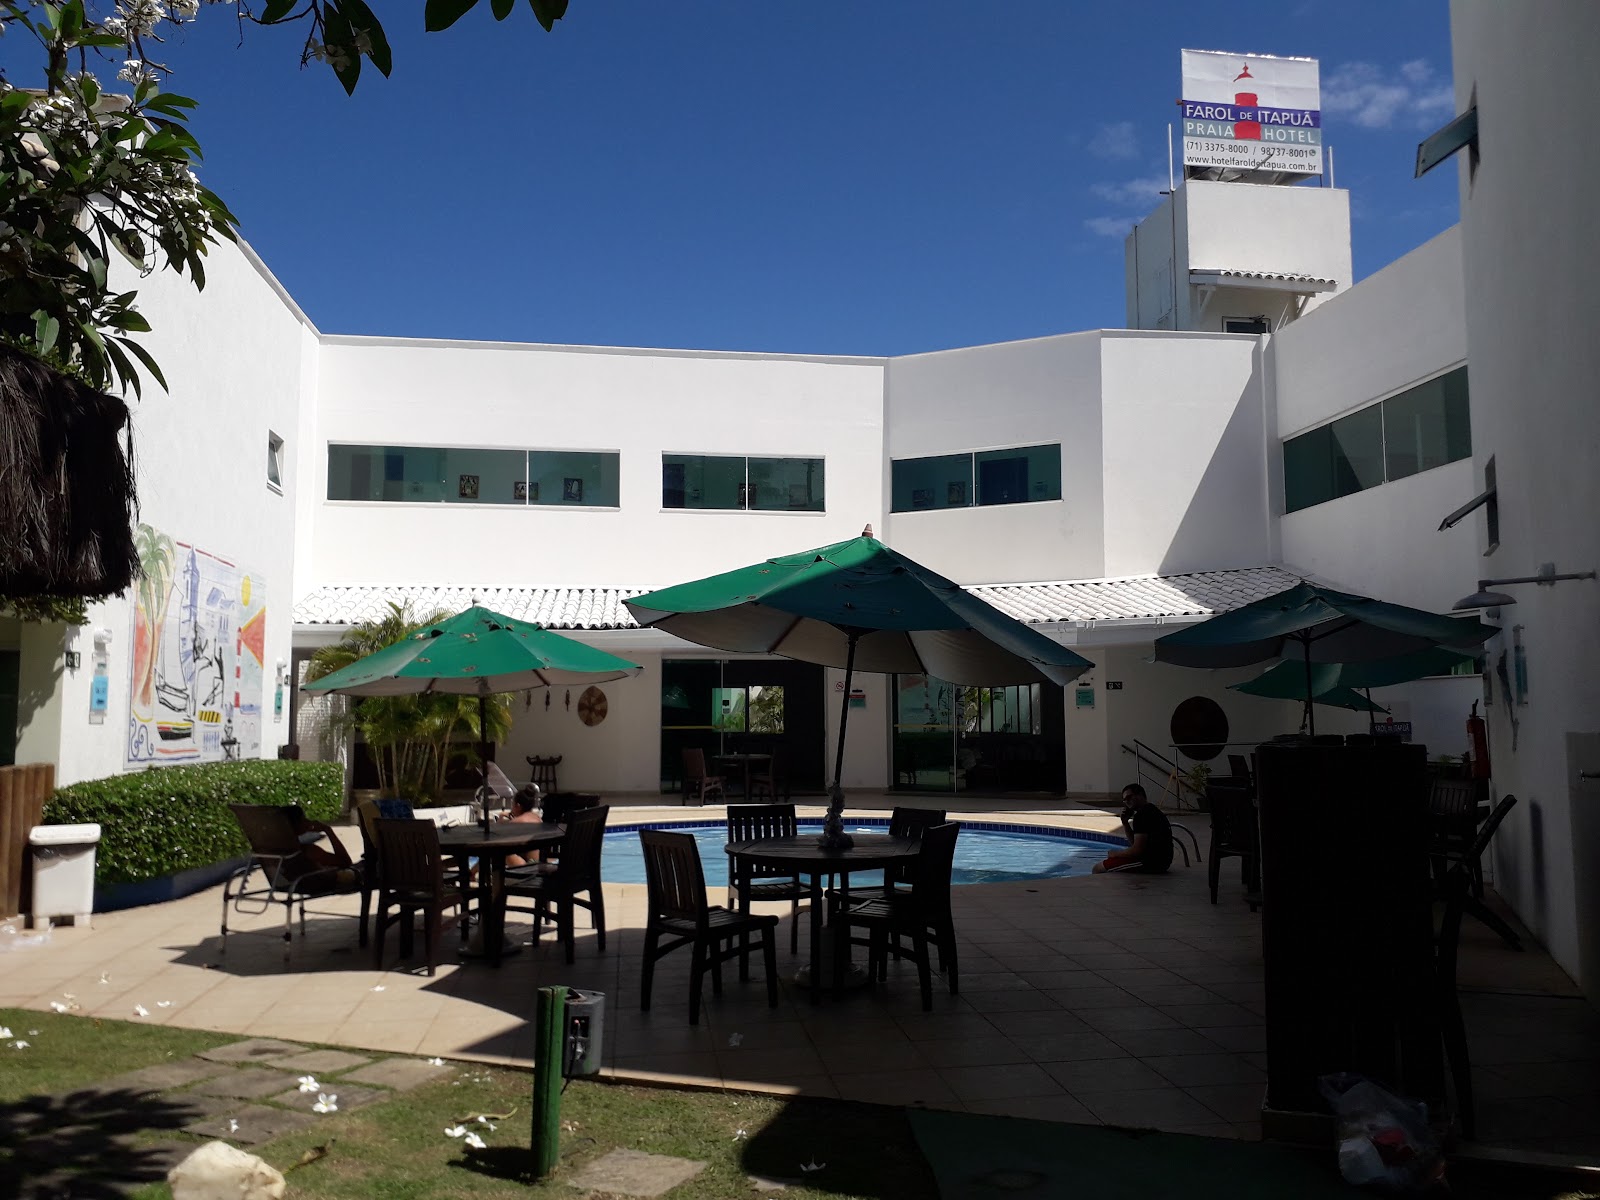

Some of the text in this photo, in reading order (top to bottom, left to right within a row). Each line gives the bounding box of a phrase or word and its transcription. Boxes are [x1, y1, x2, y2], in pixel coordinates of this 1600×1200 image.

[1186, 105, 1313, 126] FAROL DE ITAPUÃ
[1187, 122, 1314, 143] PRAIA HOTEL
[1186, 141, 1202, 152] (71)
[1205, 143, 1248, 154] 3375-8000
[1261, 146, 1308, 158] 98737-8001
